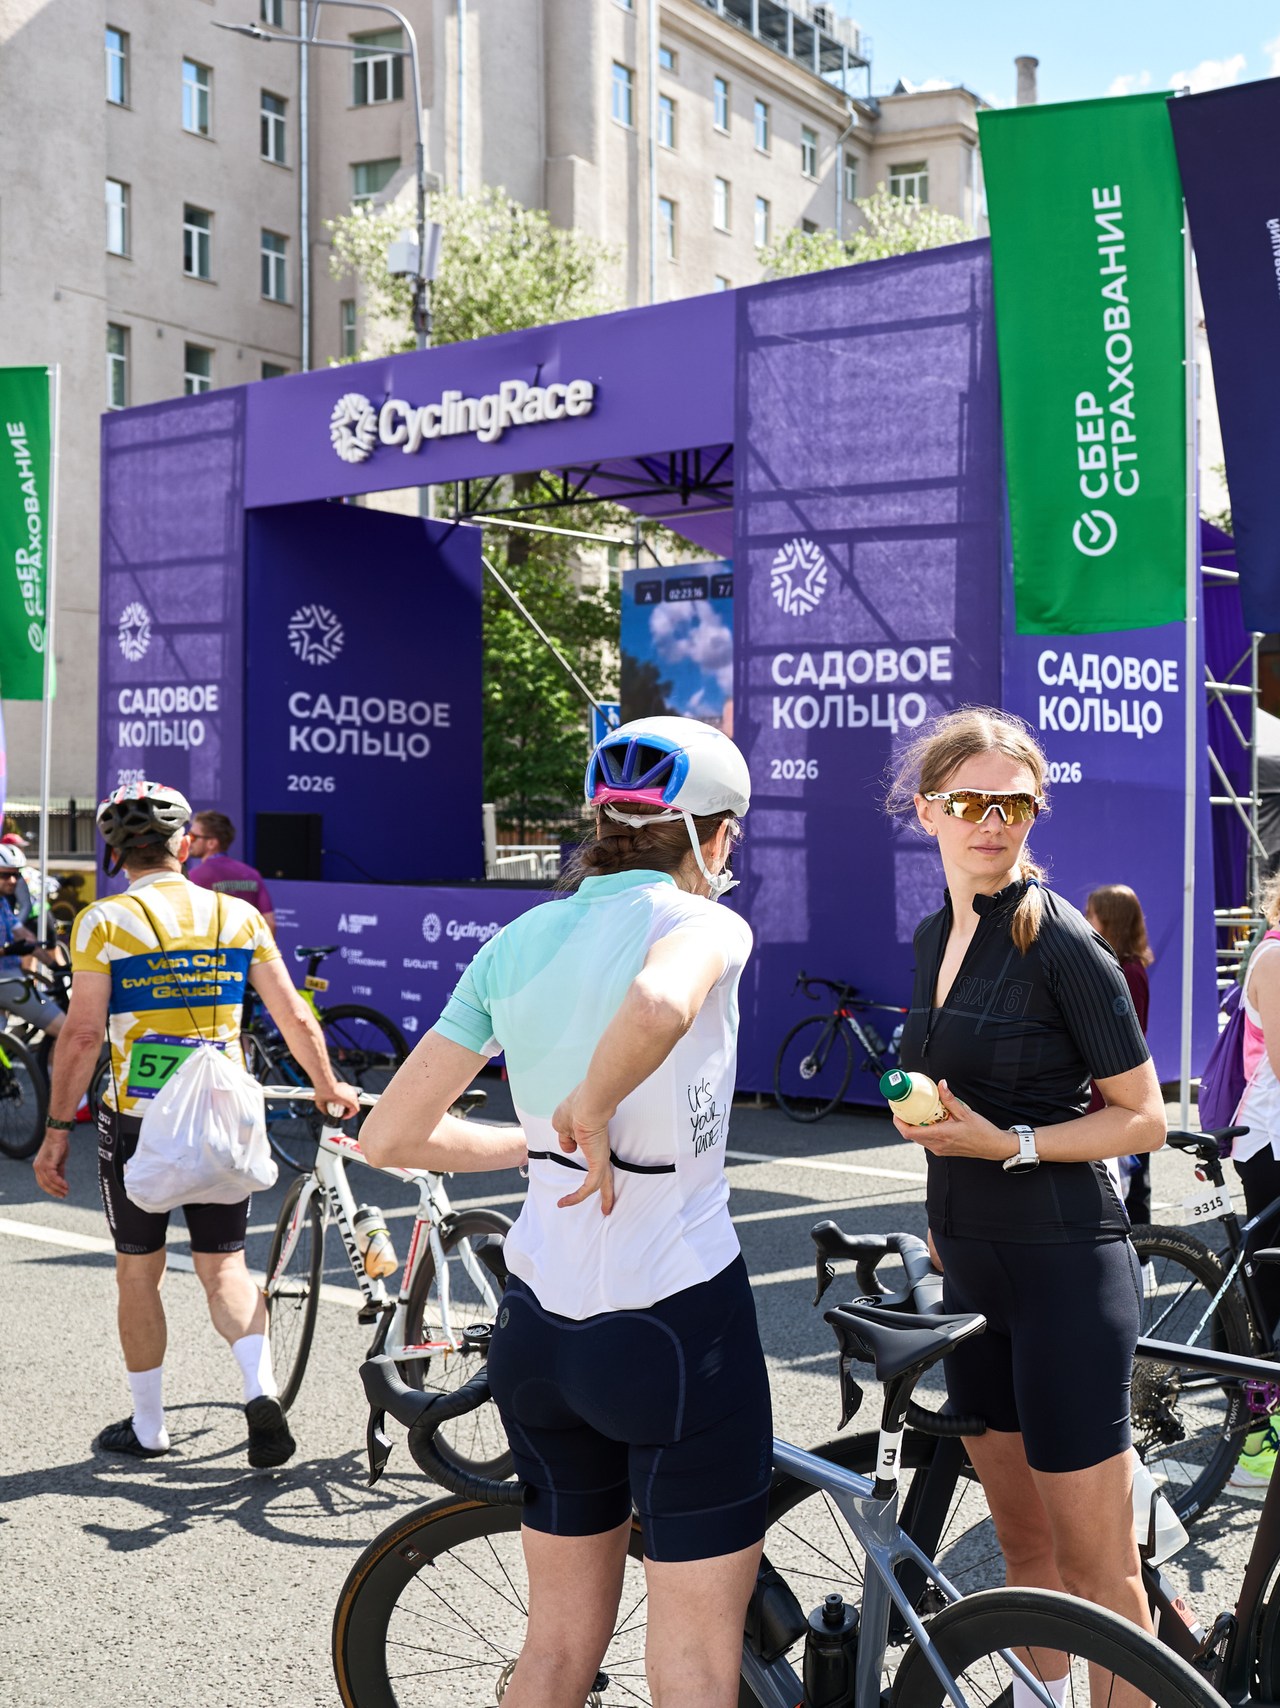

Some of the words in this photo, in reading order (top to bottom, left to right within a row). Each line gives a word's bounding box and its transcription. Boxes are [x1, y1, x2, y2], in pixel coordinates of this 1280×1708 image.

[1092, 184, 1140, 497] СТРАХОВАНИЕ
[378, 379, 593, 454] CyclingRace
[1075, 391, 1109, 499] СБЕР
[771, 646, 952, 688] САДОВОЕ
[1037, 650, 1179, 693] САДОВОЕ
[118, 685, 218, 718] САДОВОЕ
[287, 693, 451, 728] САДОВОЕ
[772, 692, 927, 732] КОЛЬЦО
[1039, 696, 1163, 739] КОЛЬЦО
[118, 719, 205, 750] КОЛЬЦО
[288, 727, 430, 762] КОЛЬЦО
[287, 775, 335, 793] 2026
[771, 760, 818, 780] 2026
[147, 956, 189, 971] Van
[953, 975, 994, 1007] SIX
[1193, 1196, 1224, 1216] 3315
[1228, 1398, 1241, 1425] SWISS
